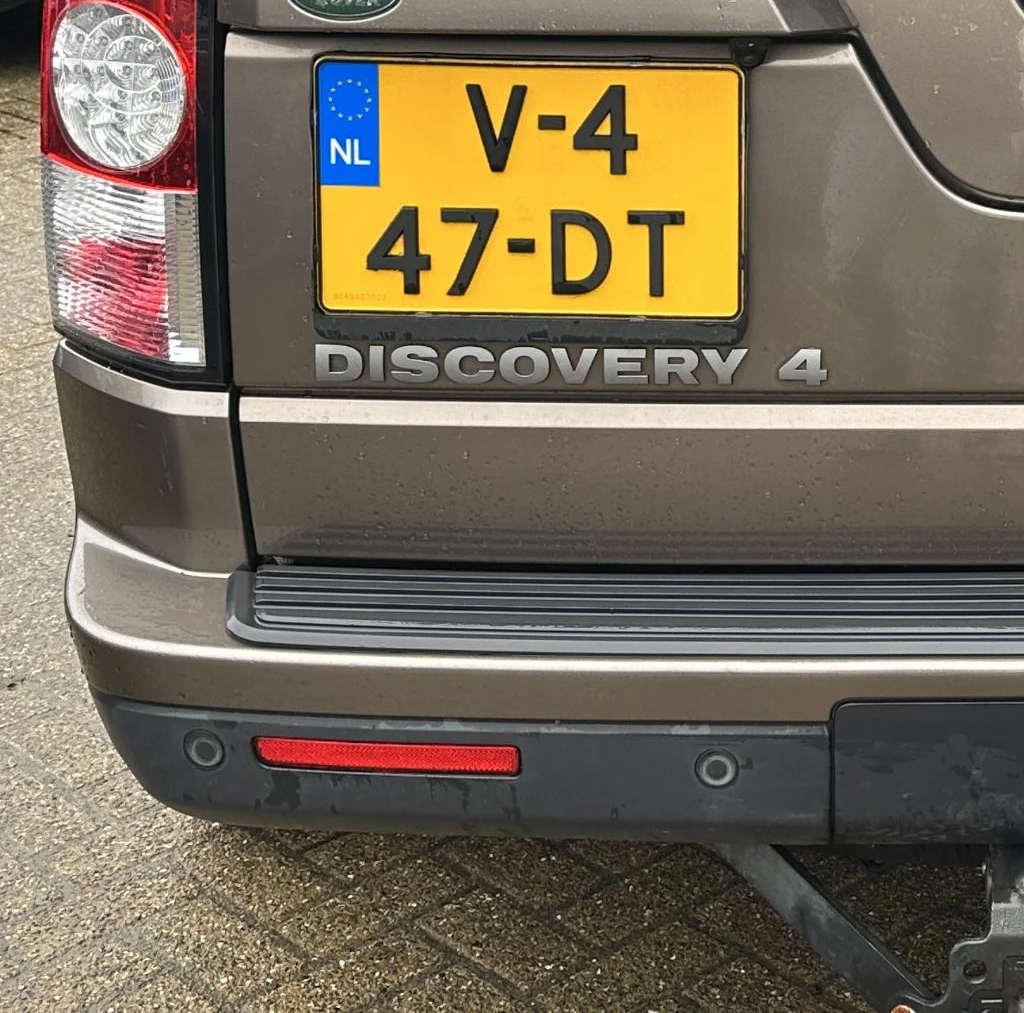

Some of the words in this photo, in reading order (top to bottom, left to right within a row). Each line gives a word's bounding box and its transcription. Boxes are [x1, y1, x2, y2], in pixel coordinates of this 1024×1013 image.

[329, 137, 371, 166] NL
[466, 83, 638, 175] V-4
[366, 206, 685, 297] 47-DT
[314, 343, 748, 385] DISCOVERY
[778, 347, 828, 386] 4
